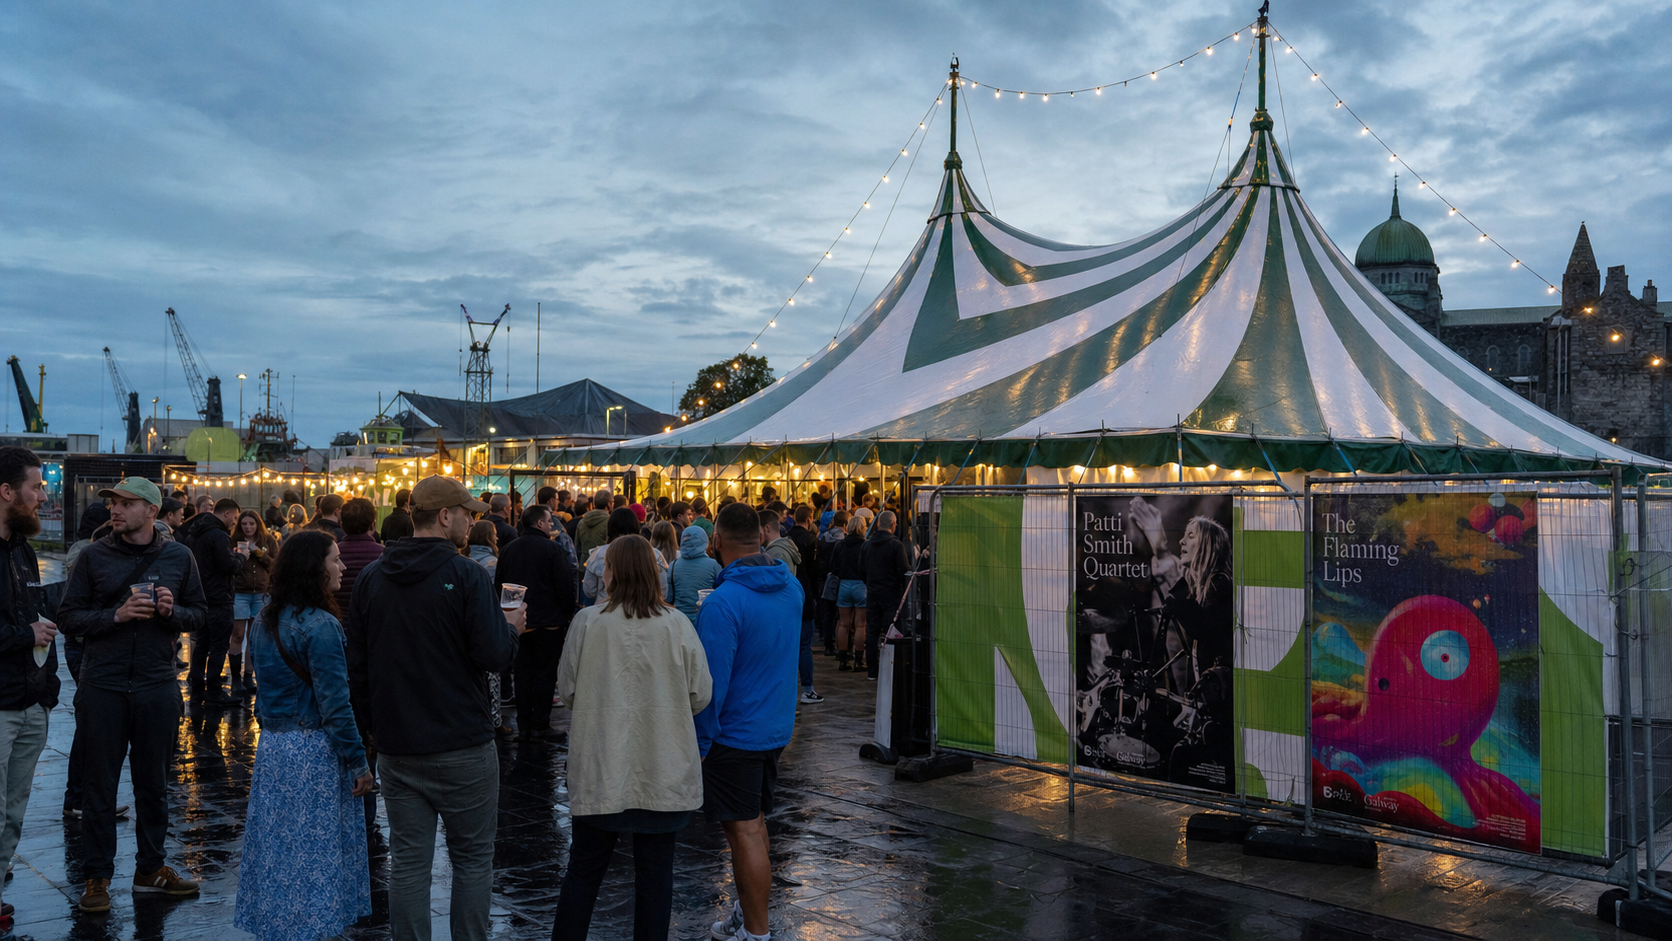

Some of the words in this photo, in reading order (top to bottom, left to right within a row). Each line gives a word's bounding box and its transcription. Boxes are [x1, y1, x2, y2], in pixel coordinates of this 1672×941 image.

[1083, 511, 1122, 532] Patti
[1321, 512, 1356, 534] The
[1083, 533, 1134, 555] Smith
[1323, 536, 1400, 567] Flaming
[1083, 556, 1148, 581] Quartet
[1323, 560, 1362, 588] Lips
[1363, 794, 1400, 814] Galway
